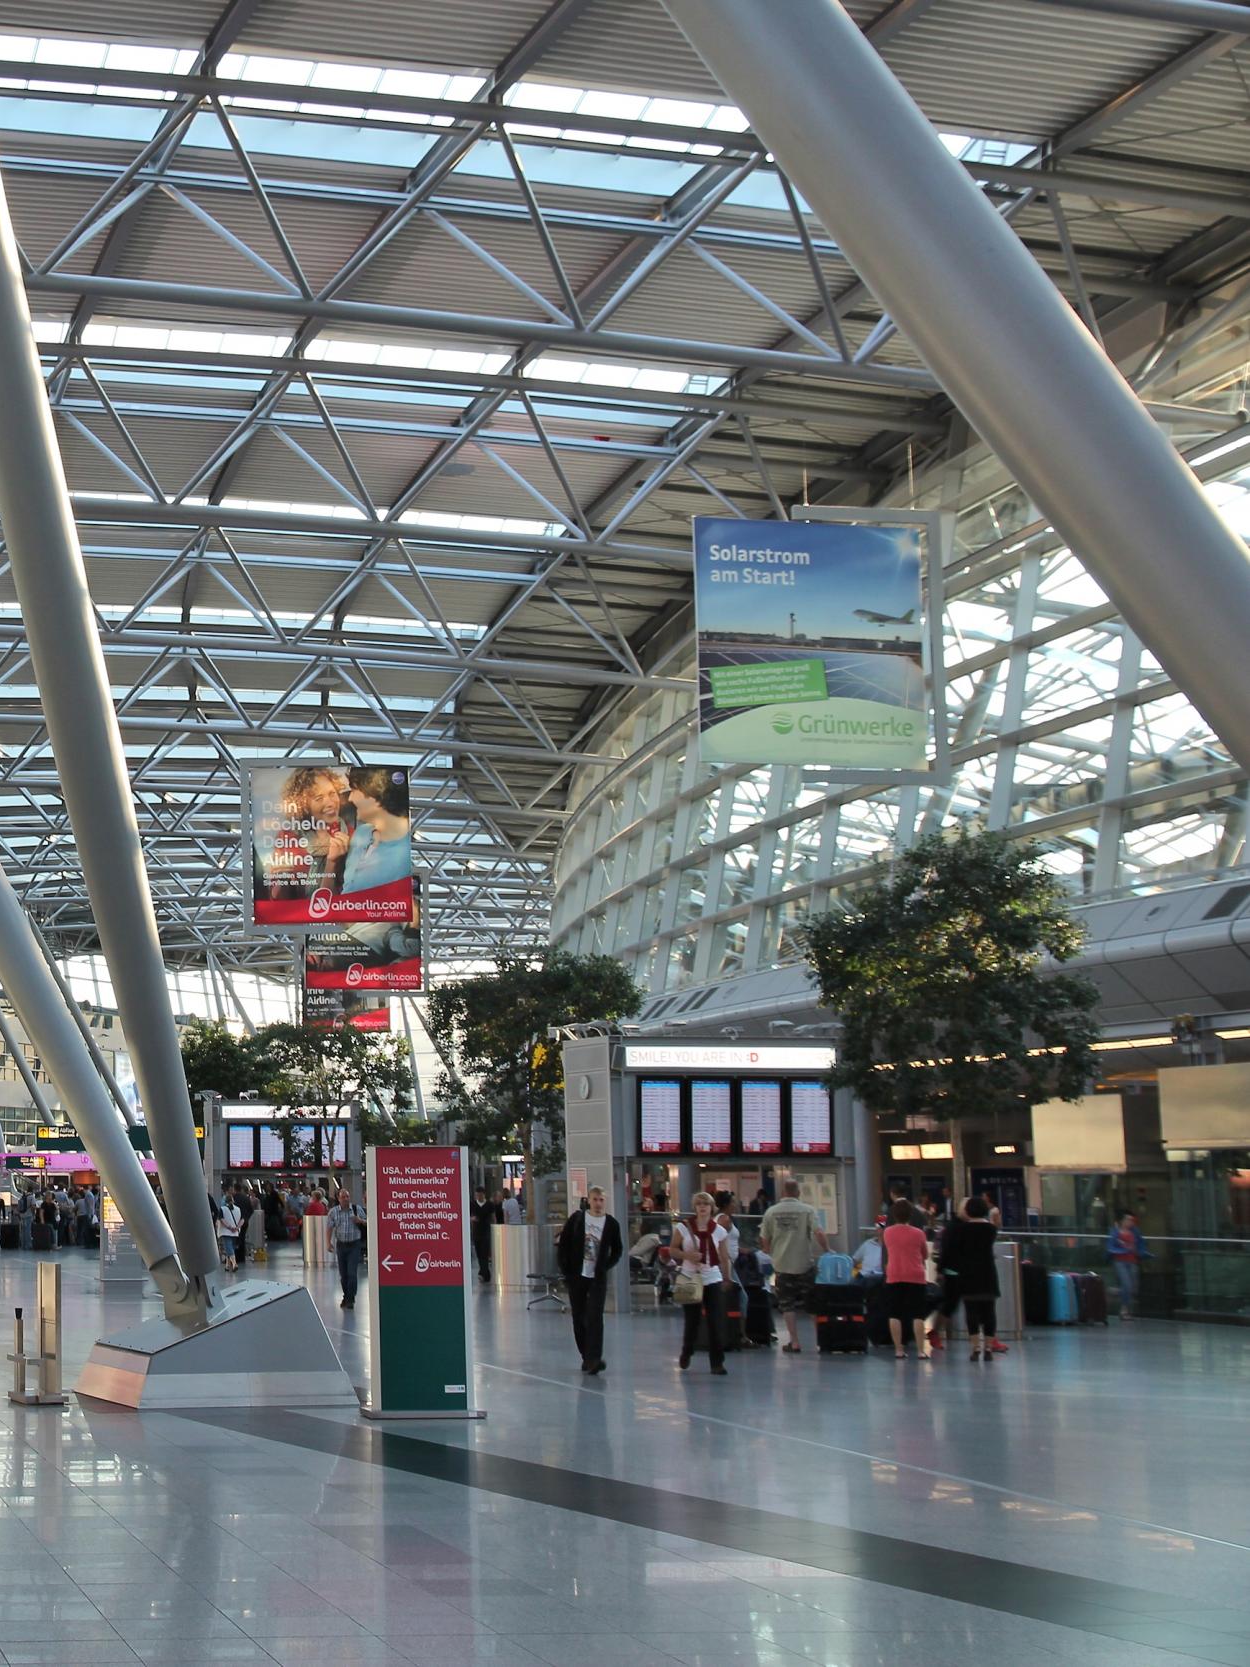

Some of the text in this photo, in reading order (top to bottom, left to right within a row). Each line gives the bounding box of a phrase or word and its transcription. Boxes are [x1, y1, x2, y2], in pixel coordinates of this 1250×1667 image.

[710, 545, 810, 565] Solarstrom
[711, 568, 795, 585] am Start!
[798, 714, 913, 737] Grünwerke
[262, 801, 298, 813] Dein
[263, 816, 330, 831] Lächeln.
[264, 835, 309, 849] Deine
[263, 852, 317, 866] Airline.
[331, 900, 407, 911] airberlin.com
[363, 973, 418, 981] airberlin.com
[307, 996, 338, 1005] Airline.
[630, 1051, 671, 1063] SMILE!
[676, 1051, 699, 1063] YOU
[703, 1052, 727, 1063] ARE
[730, 1052, 743, 1063] IN
[382, 1167, 403, 1175] USA,
[382, 1212, 458, 1221] Langstreckenflüge
